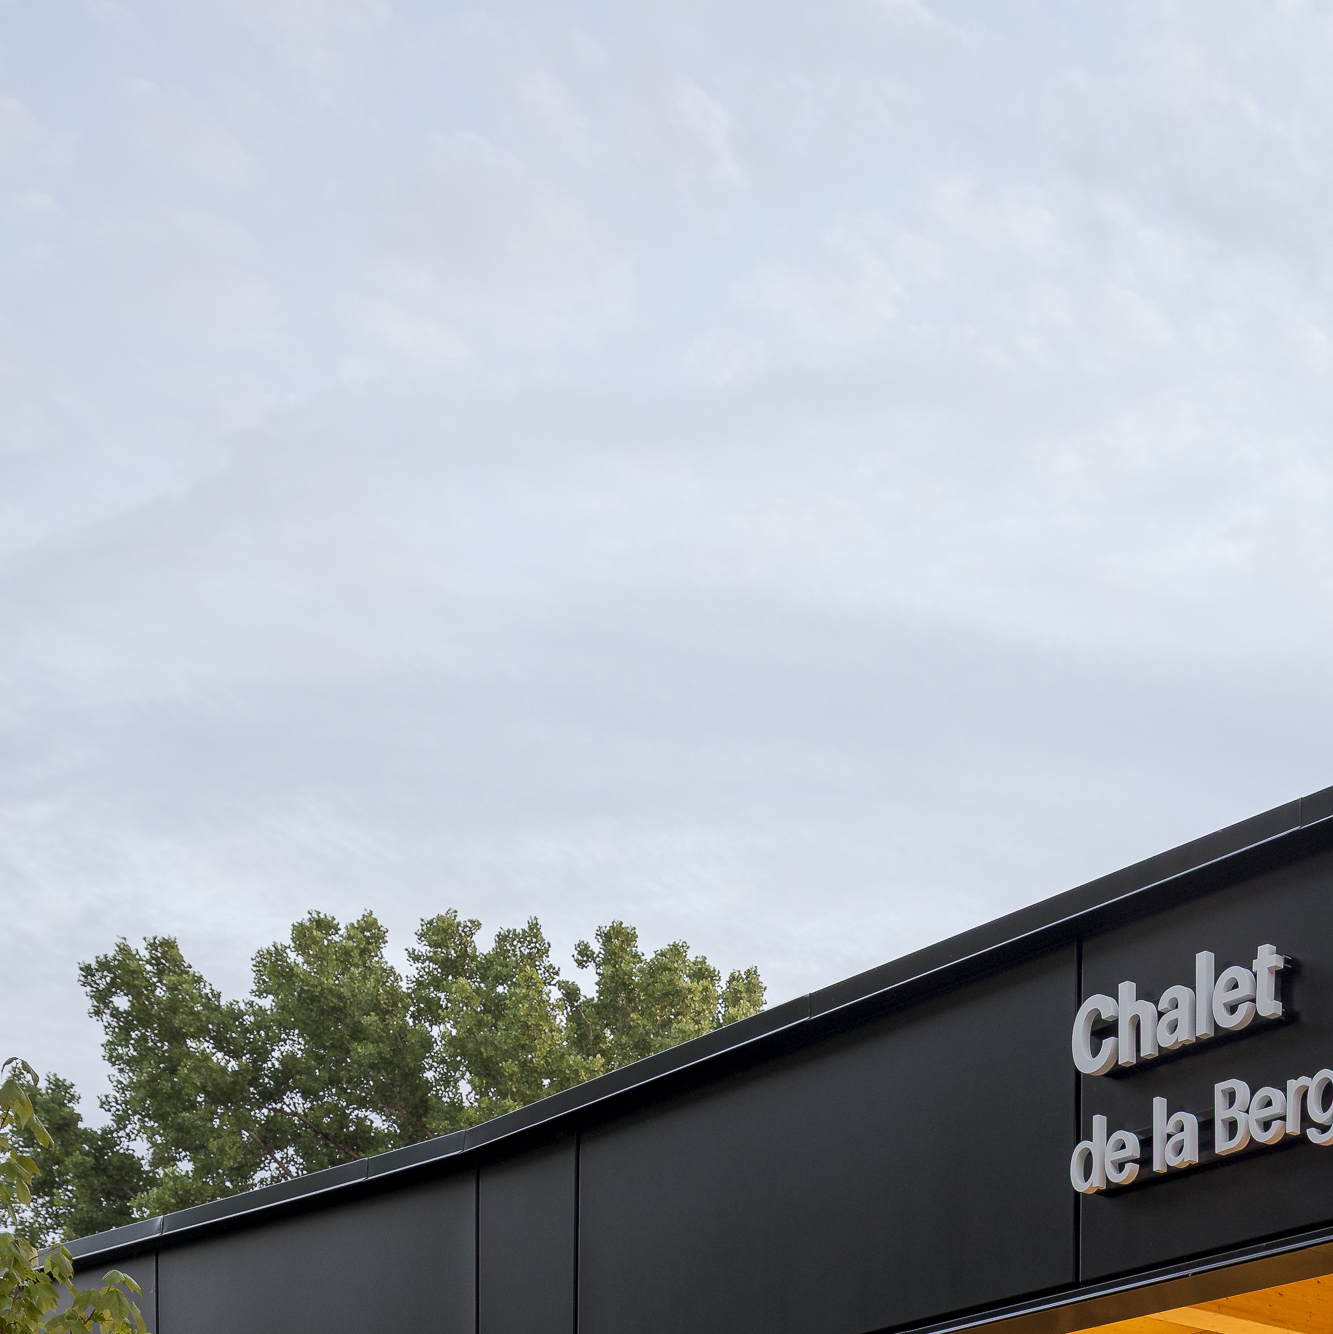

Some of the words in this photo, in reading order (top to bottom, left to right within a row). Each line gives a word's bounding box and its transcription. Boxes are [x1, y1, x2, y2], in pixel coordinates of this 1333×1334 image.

[1072, 944, 1284, 1076] Chalet
[1070, 1114, 1140, 1194] de
[1153, 1096, 1198, 1173] la
